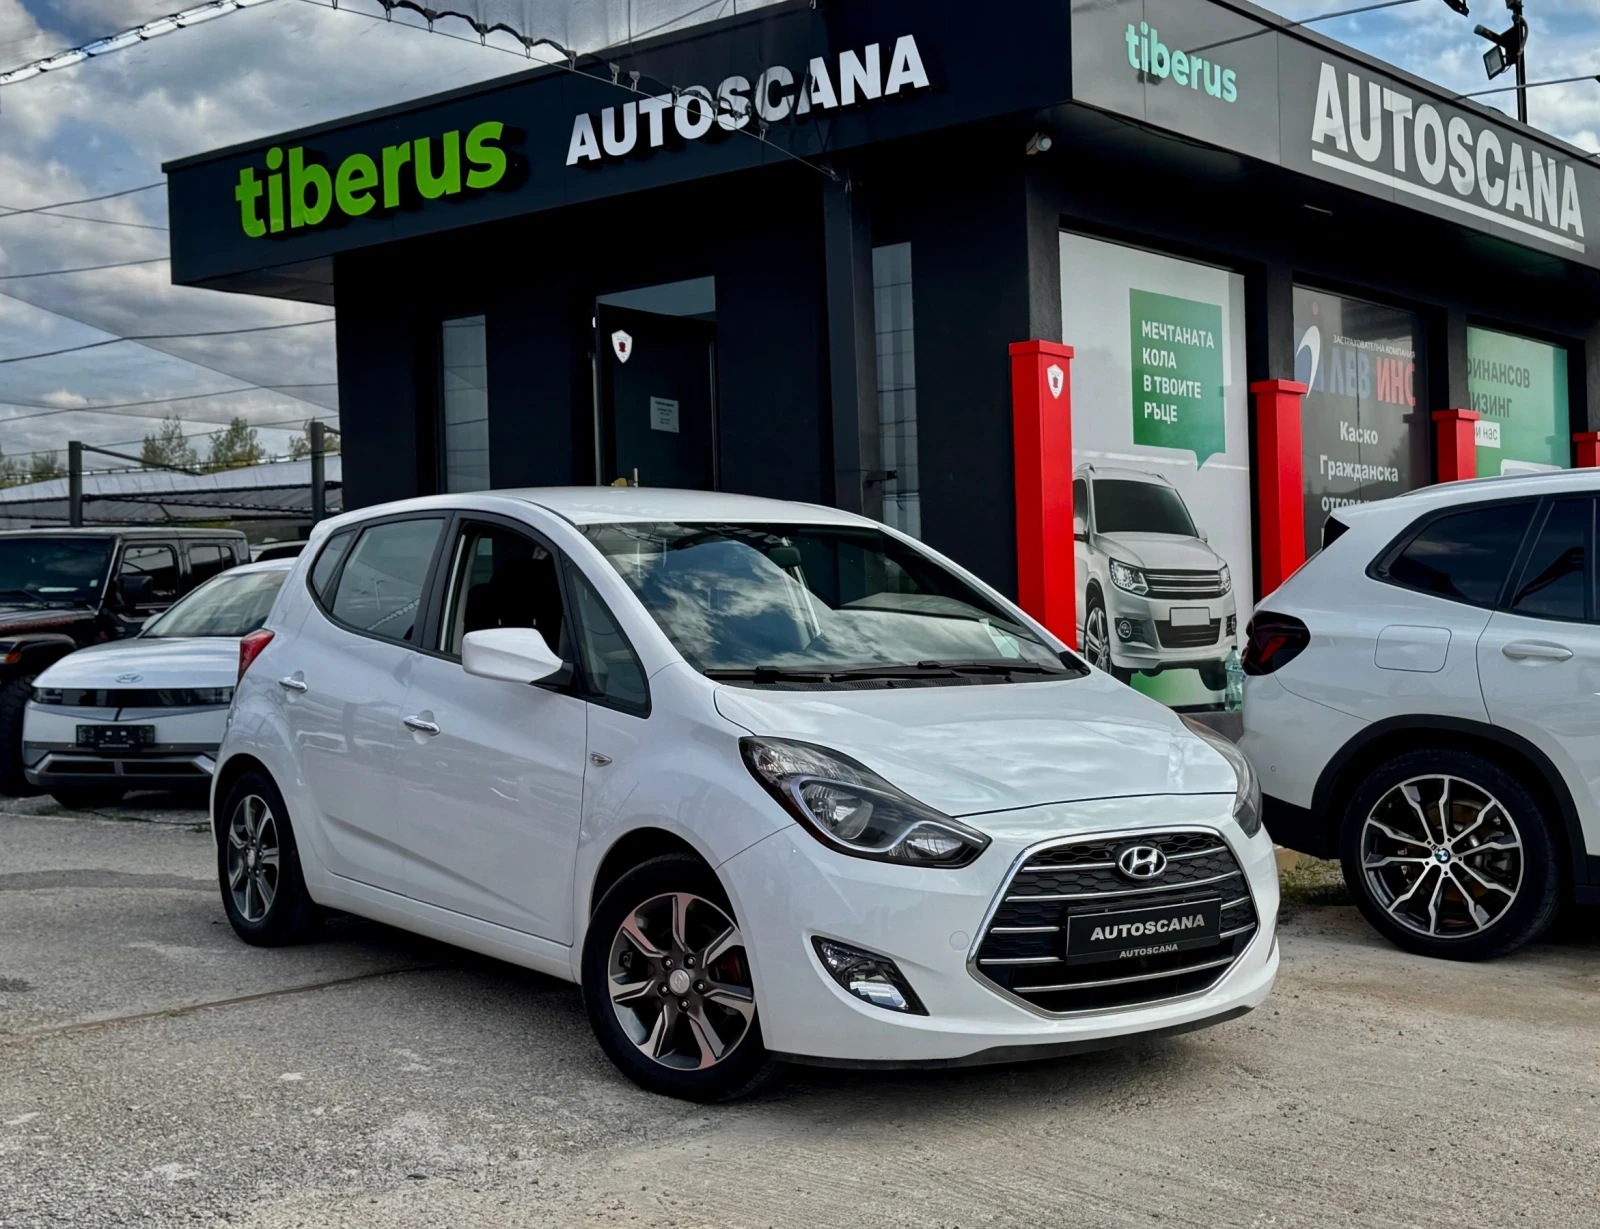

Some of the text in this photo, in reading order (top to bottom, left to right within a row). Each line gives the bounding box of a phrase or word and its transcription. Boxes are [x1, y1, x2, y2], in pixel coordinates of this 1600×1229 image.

[1126, 21, 1239, 103] tiberus
[566, 34, 931, 166] AUTOSCANA
[1312, 62, 1585, 238] AUTOSCANA
[235, 121, 508, 239] tiberus
[1142, 320, 1215, 349] МЕЧТАНАТА
[1142, 347, 1177, 369] КОЛА
[1143, 374, 1202, 399] В ТВОИТЕ
[1329, 346, 1416, 407] ЛЕВ ИНС
[1144, 402, 1178, 424] РЪЦЕ
[1340, 421, 1379, 445] Каско
[1483, 428, 1498, 441] нас
[1320, 454, 1399, 482] Гражданска
[1090, 913, 1206, 941] AUTOSCANA
[1119, 943, 1179, 959] AUTOSCANA
